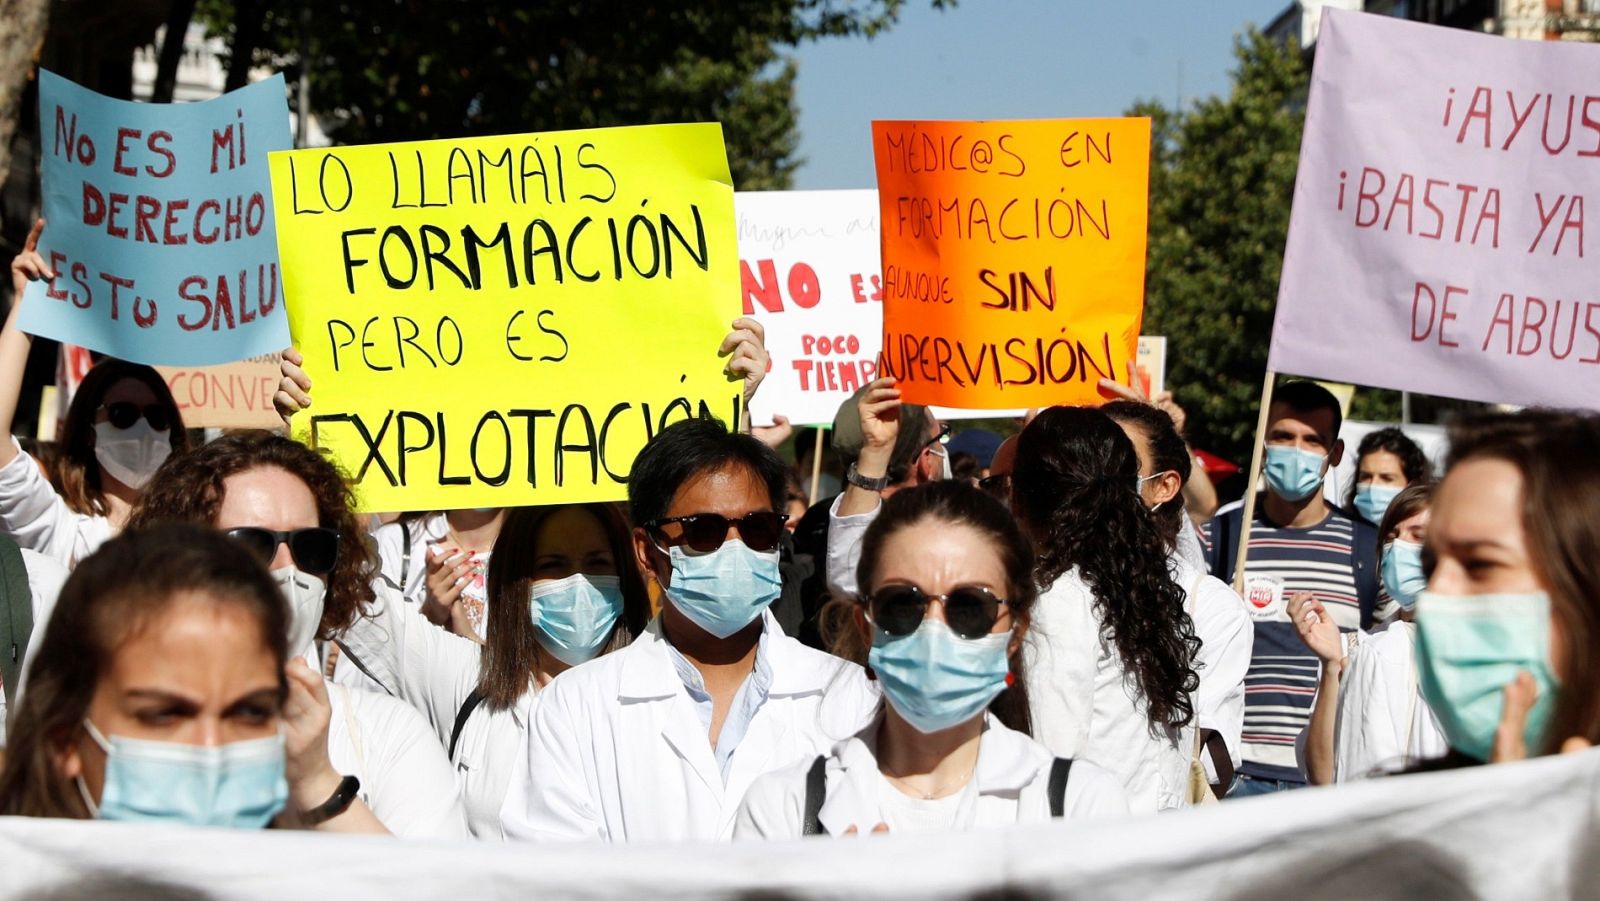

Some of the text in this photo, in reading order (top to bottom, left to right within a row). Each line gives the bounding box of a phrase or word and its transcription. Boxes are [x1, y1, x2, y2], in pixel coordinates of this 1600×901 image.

[113, 127, 176, 178] ES
[289, 137, 617, 215] LO LLAMÁIS
[886, 123, 1112, 177] MÉDIC@S EN
[82, 180, 266, 245] DERECHO
[896, 186, 1110, 244] FORMACIÓN
[1337, 167, 1585, 259] ¡BASTA YA
[341, 198, 709, 295] FORMACIÓN
[46, 251, 92, 310] ES
[738, 257, 822, 316] NO
[885, 264, 1057, 313] AUNQUE SIN
[327, 309, 569, 371] PERO ES
[1410, 281, 1470, 348] DE
[801, 333, 860, 356] POCO
